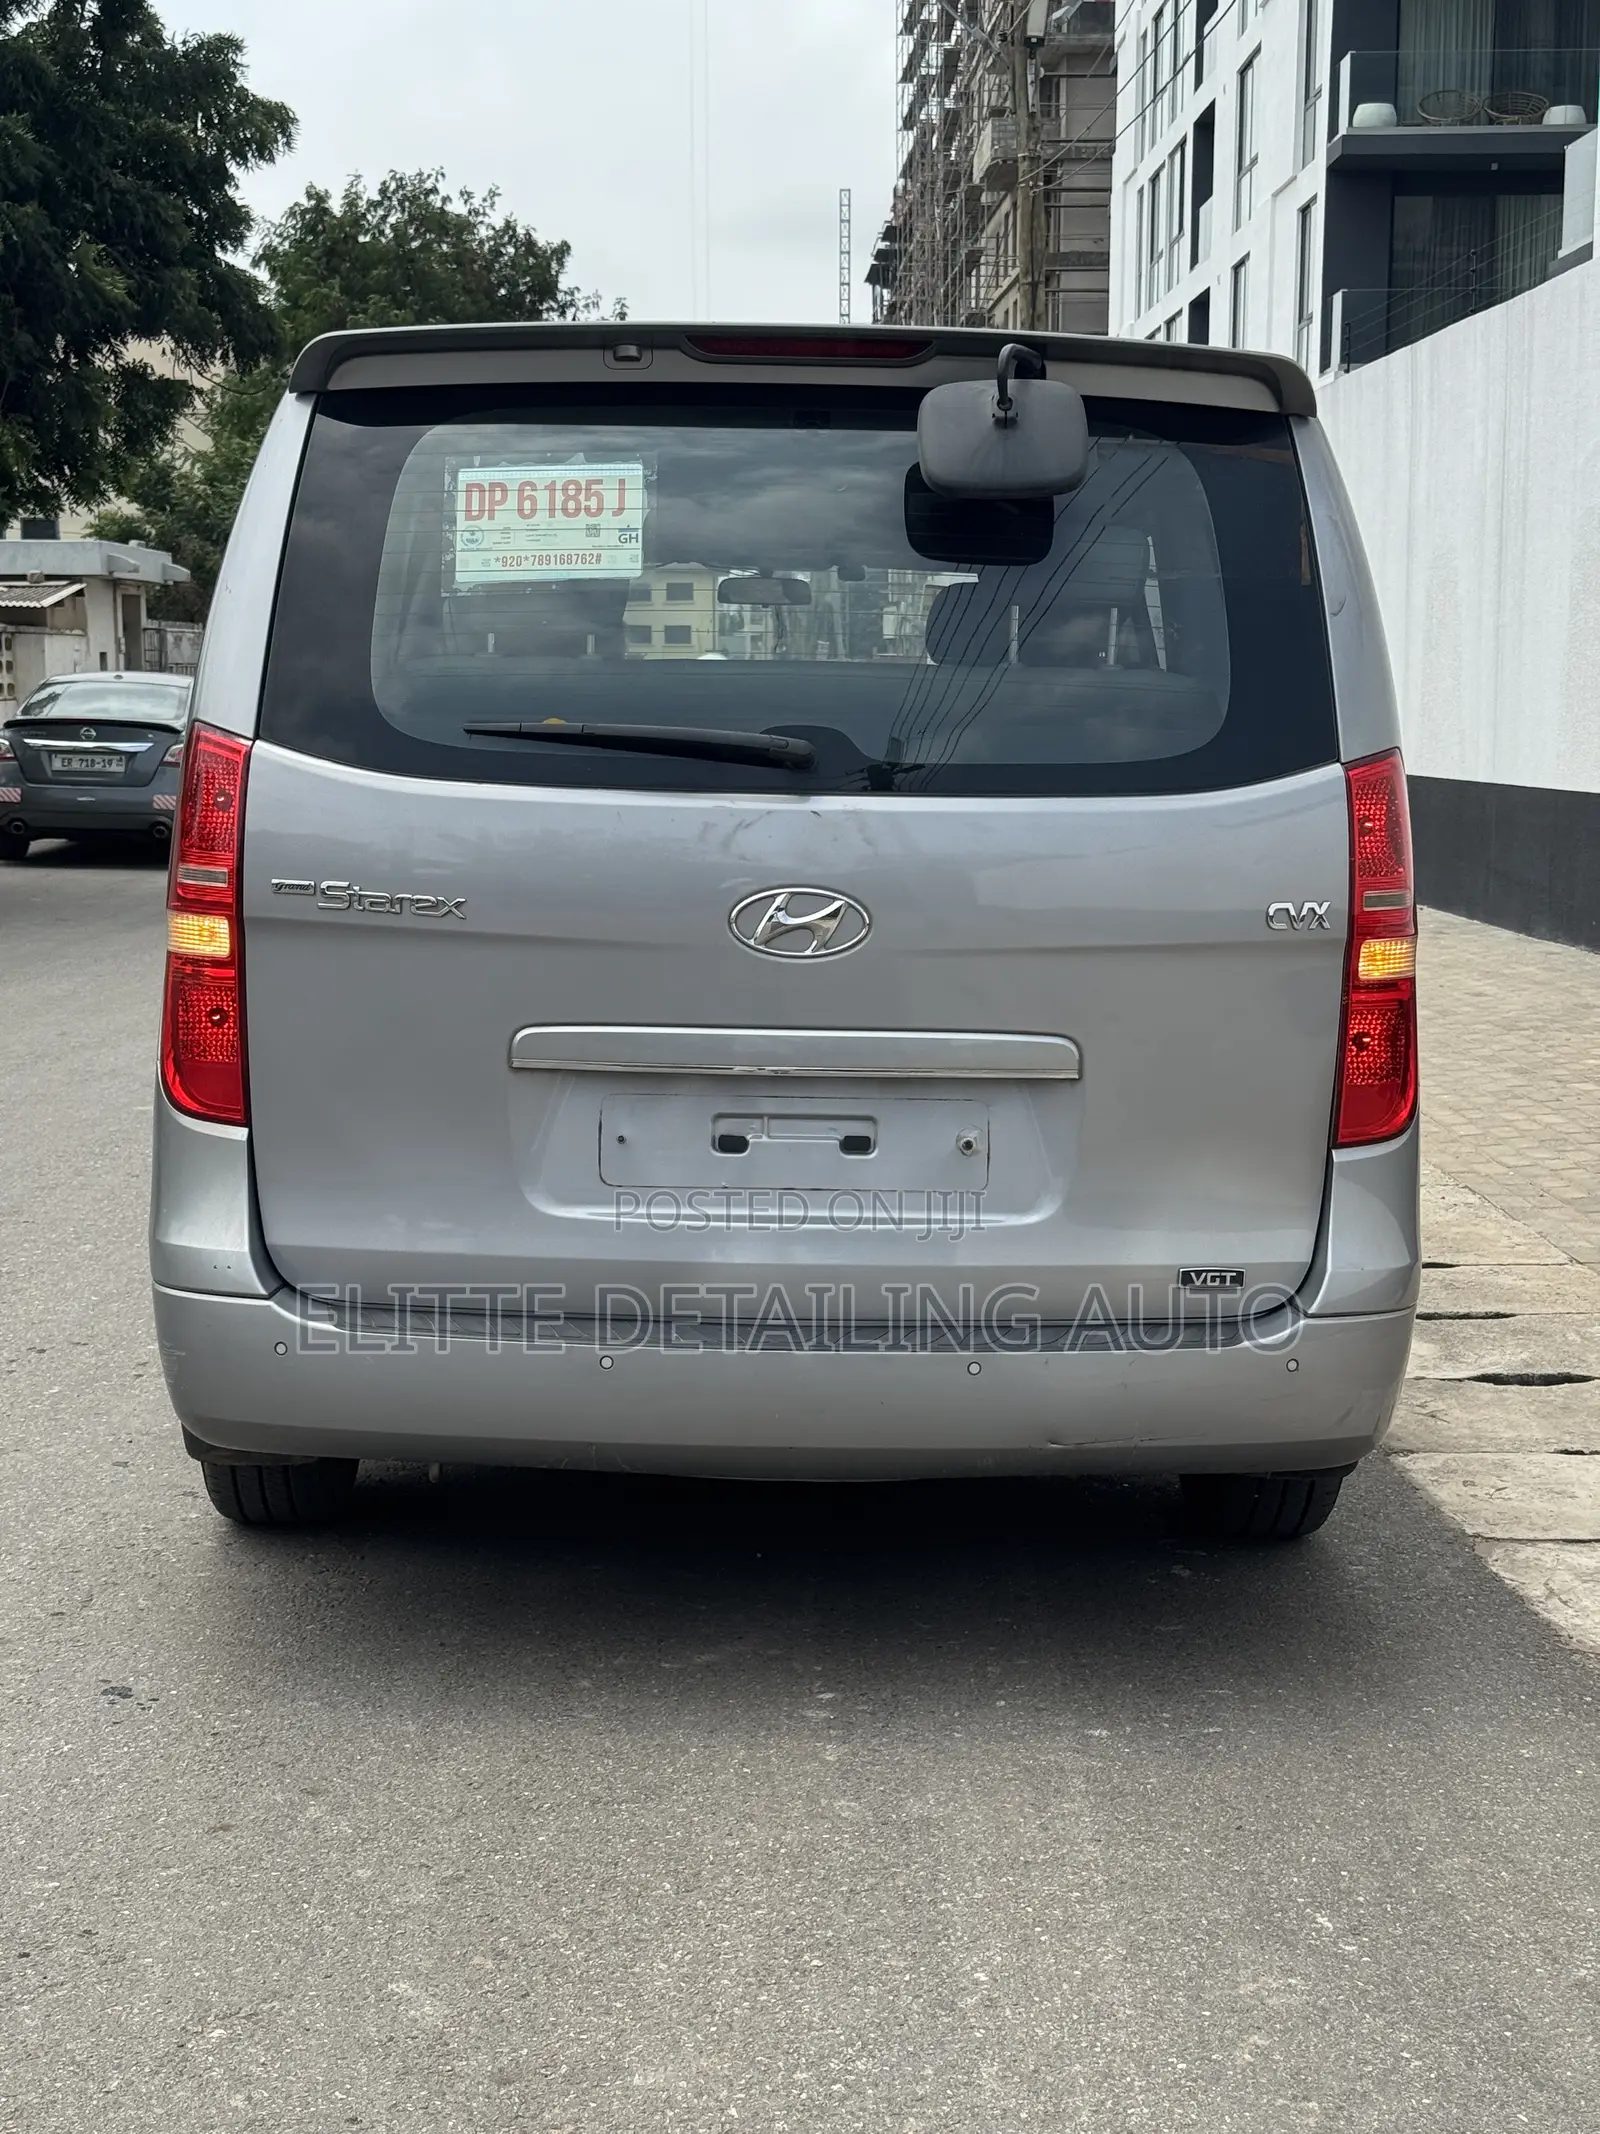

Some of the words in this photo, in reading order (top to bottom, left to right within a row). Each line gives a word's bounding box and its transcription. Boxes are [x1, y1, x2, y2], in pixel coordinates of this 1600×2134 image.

[465, 481, 509, 521] DP
[517, 479, 604, 520] 6185
[612, 478, 627, 517] J
[618, 533, 639, 544] GH
[61, 758, 73, 768] ER
[317, 880, 467, 919] Starex
[1266, 901, 1331, 930] CVX
[1190, 1272, 1236, 1286] VGT
